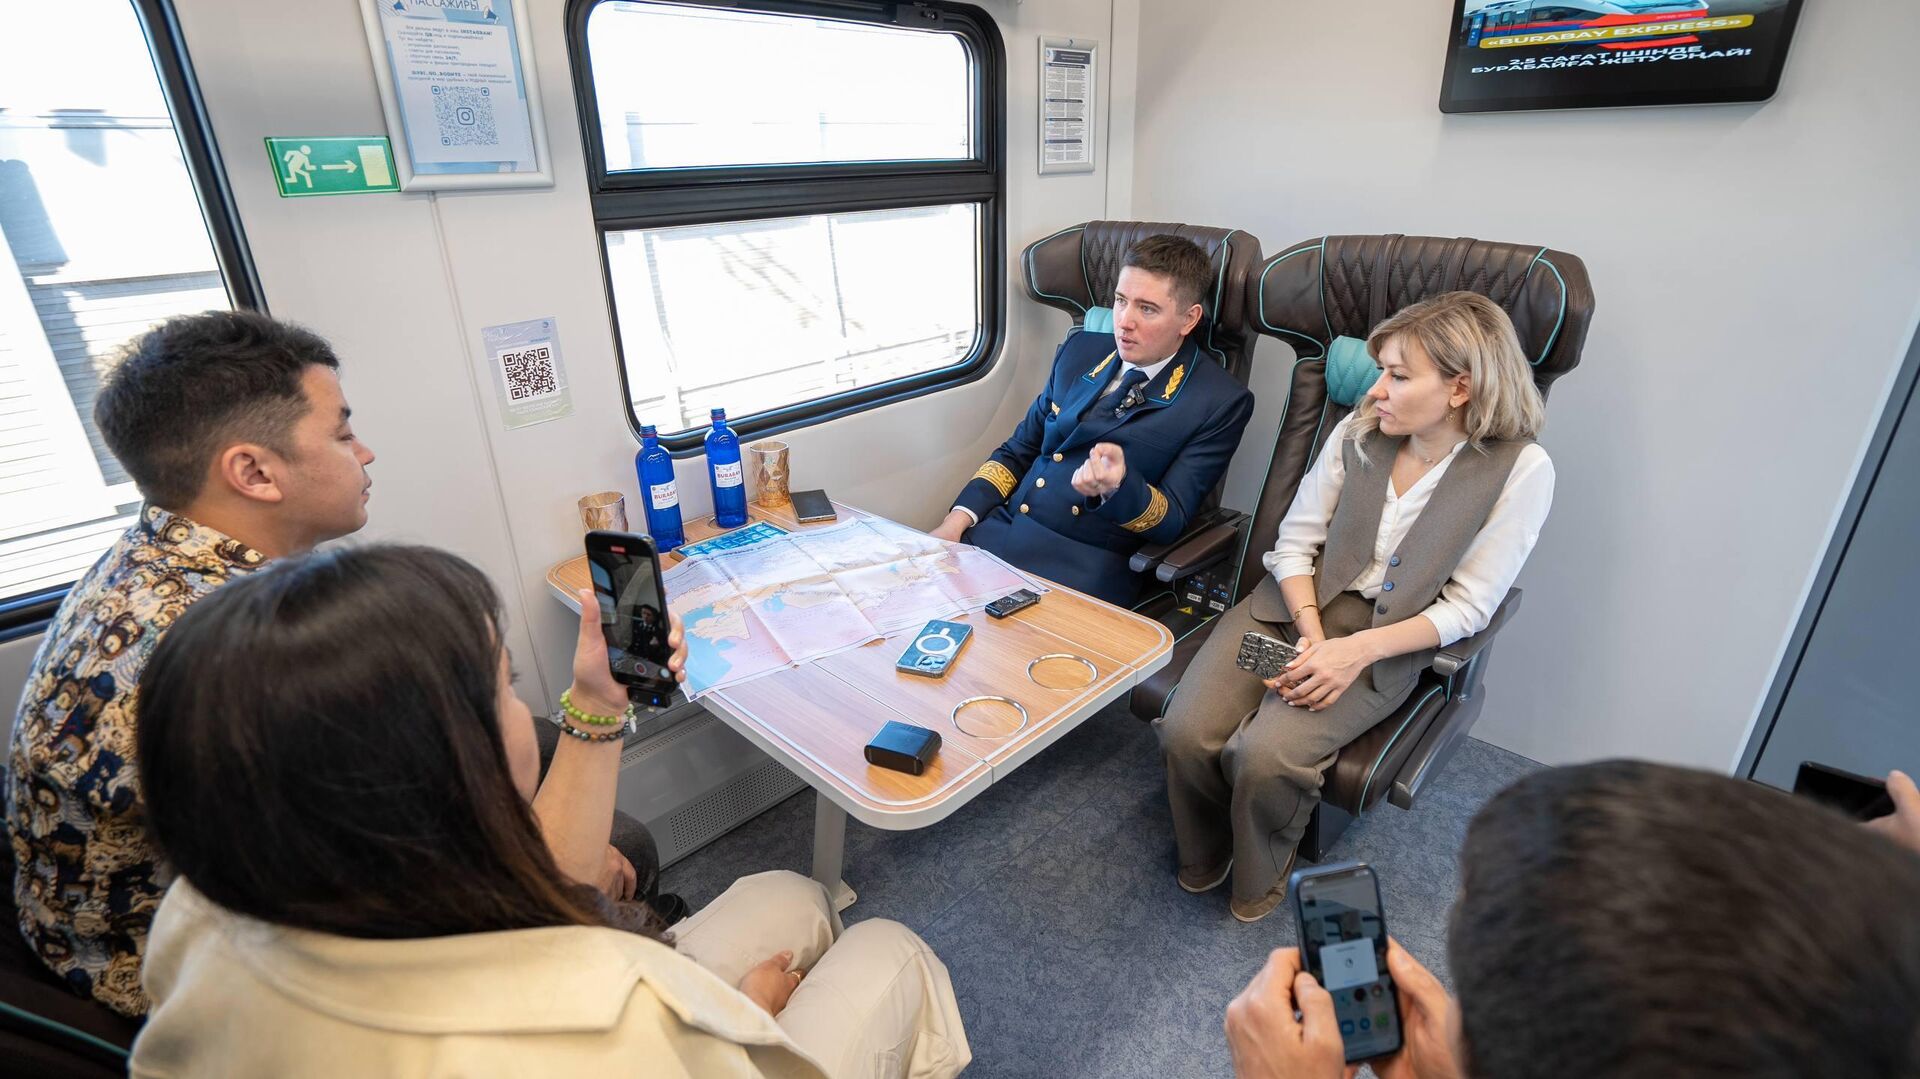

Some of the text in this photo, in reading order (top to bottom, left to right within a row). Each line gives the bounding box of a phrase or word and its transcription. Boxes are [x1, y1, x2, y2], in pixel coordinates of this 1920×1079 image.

[1488, 19, 1741, 46] «BURABAY EXPRESS»
[1599, 54, 1665, 65] ЖЕТУ
